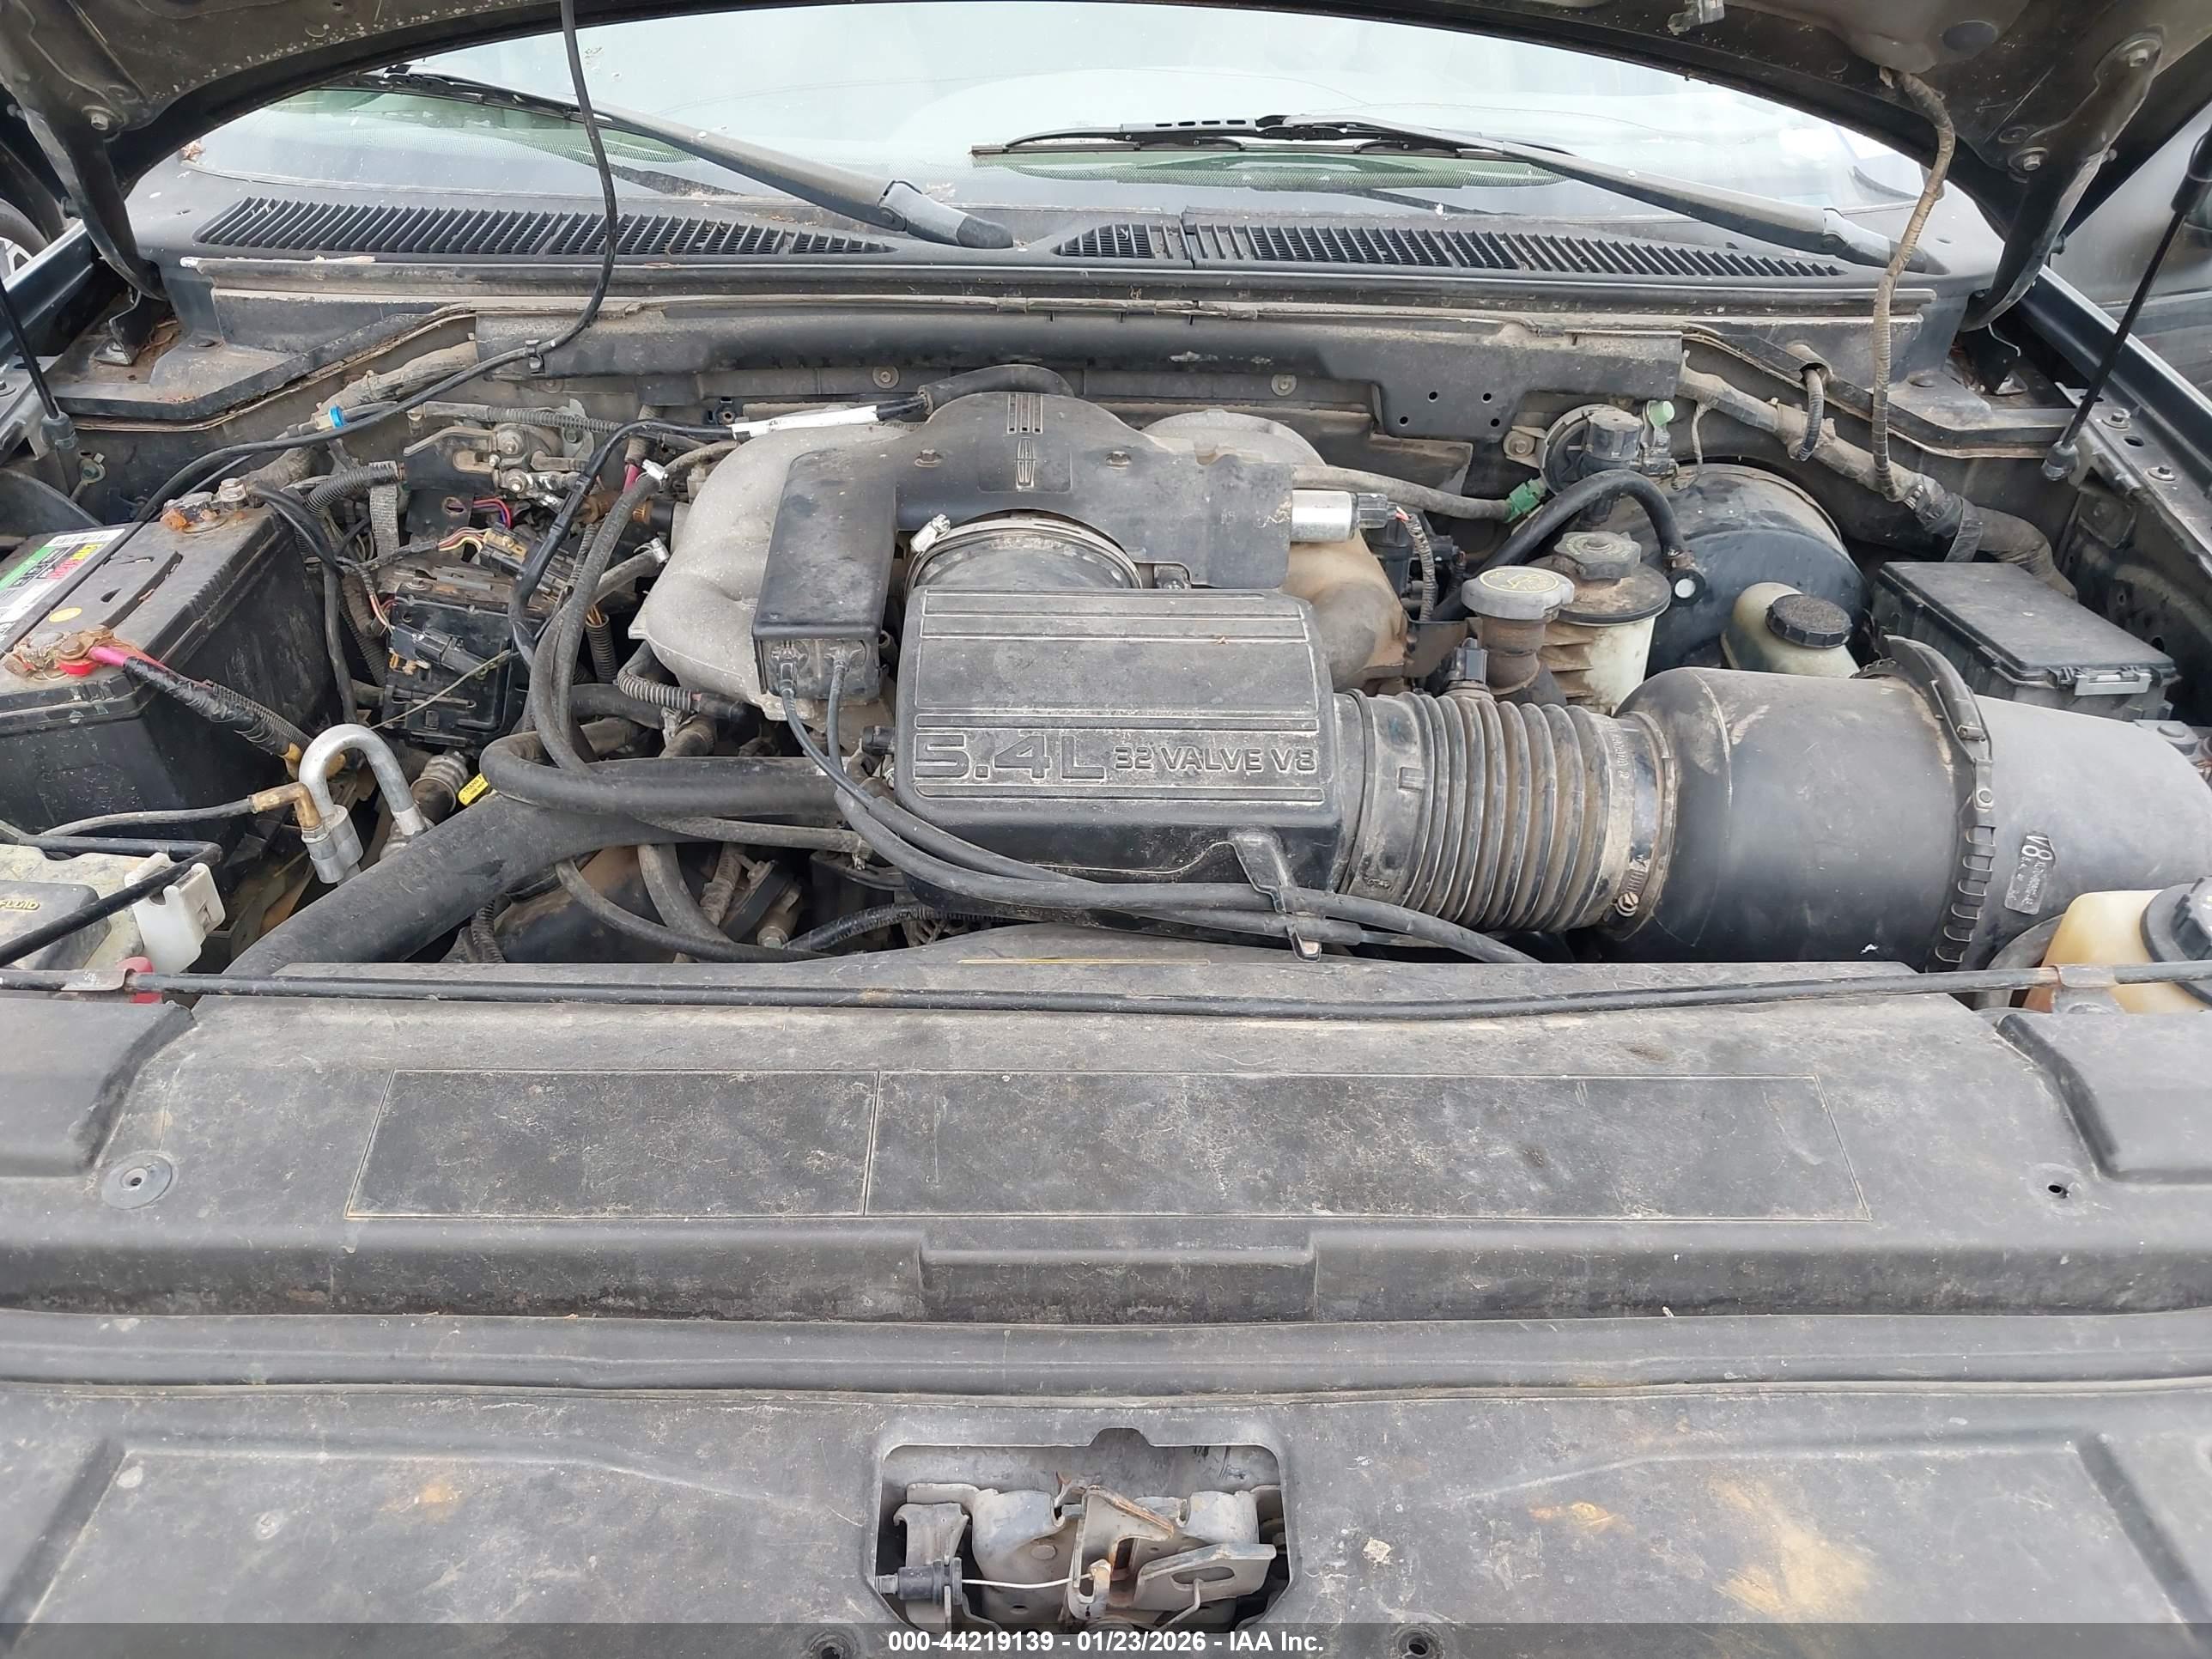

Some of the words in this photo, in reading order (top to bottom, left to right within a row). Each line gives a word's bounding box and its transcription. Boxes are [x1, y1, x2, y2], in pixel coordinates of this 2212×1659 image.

[914, 733, 1107, 781] 5.4L
[1115, 746, 1154, 771] 32
[1160, 747, 1263, 772] VALVE
[1271, 748, 1317, 773] V8
[2021, 835, 2053, 860] V8
